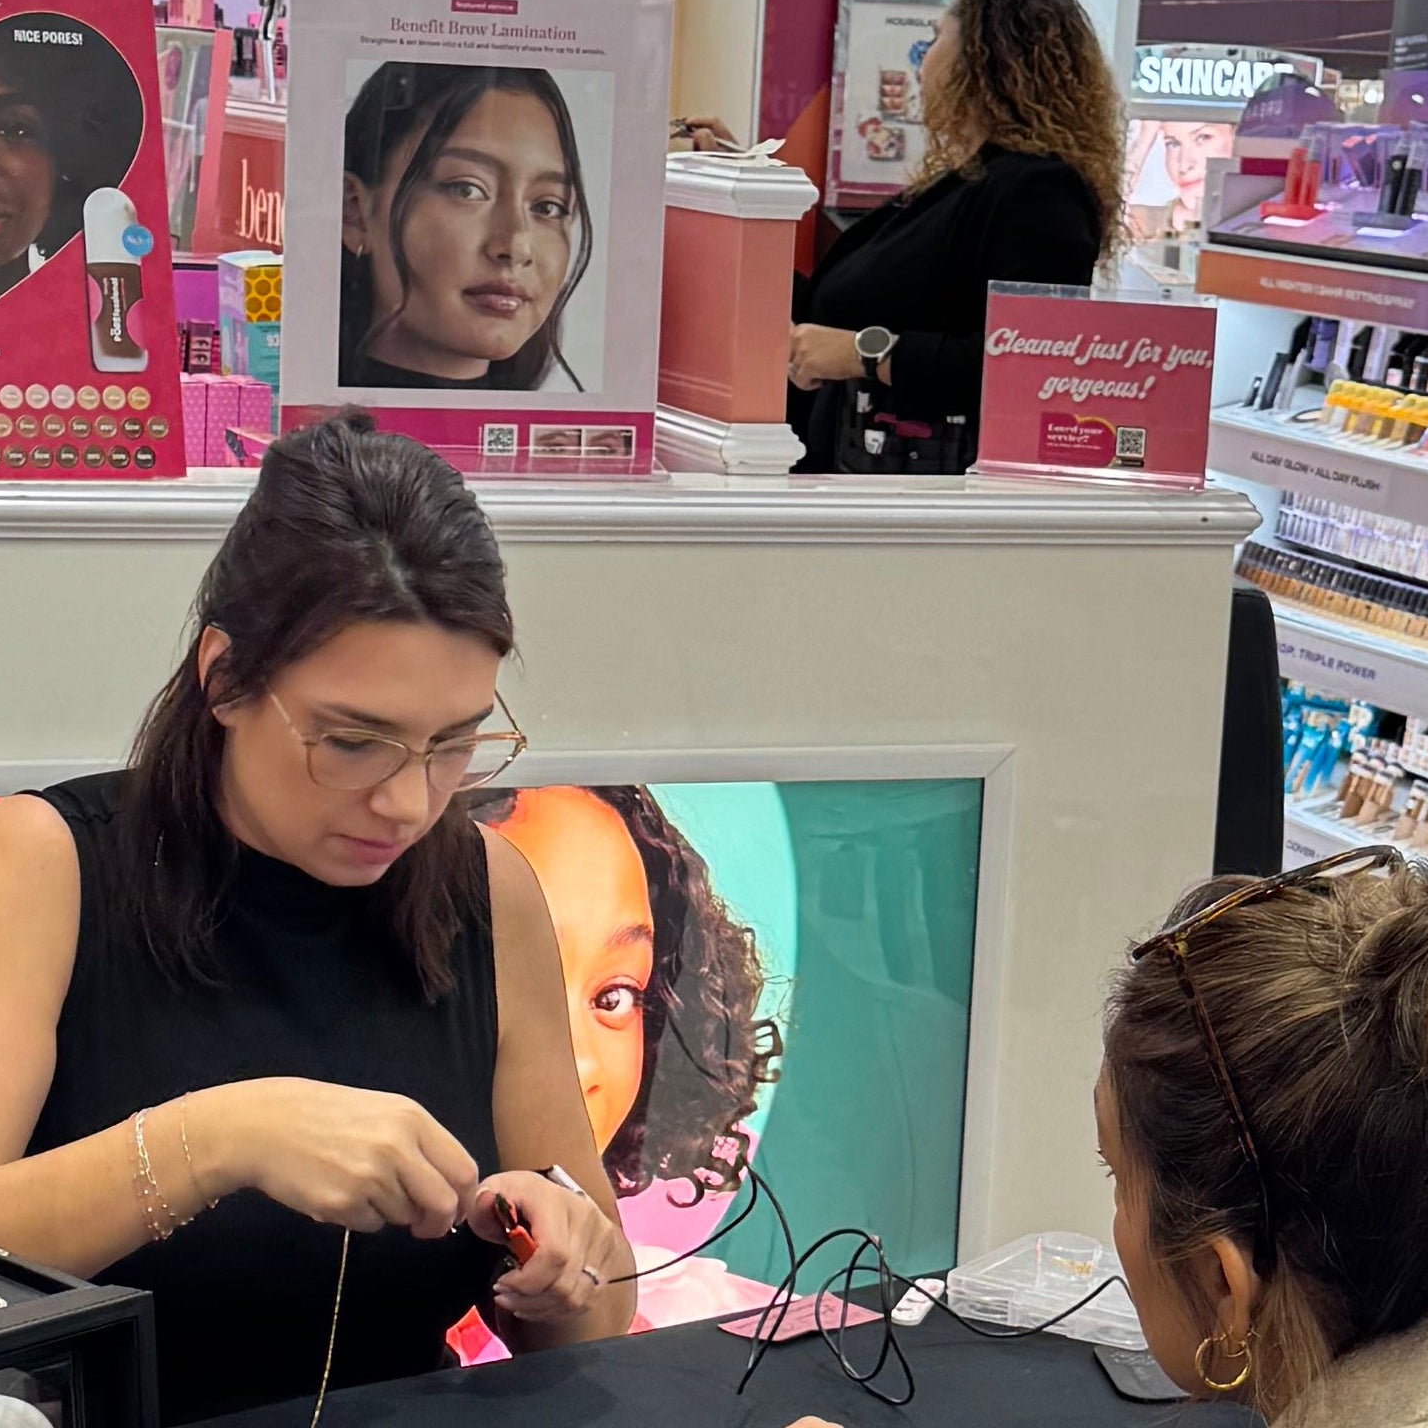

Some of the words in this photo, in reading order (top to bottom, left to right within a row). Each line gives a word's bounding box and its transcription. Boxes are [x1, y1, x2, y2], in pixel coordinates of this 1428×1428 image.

[14, 29, 41, 43] NICE
[43, 31, 83, 45] PORES!
[390, 17, 444, 33] Benefit
[448, 20, 488, 36] Brow
[492, 23, 577, 41] Lamination
[1139, 56, 1294, 99] SKINCAR
[239, 159, 284, 246] ben
[986, 328, 1083, 356] Cleaned
[1074, 335, 1128, 365] just
[1124, 338, 1162, 368] for
[1162, 344, 1214, 371] you,
[1038, 375, 1156, 402] gorgeous!
[1299, 648, 1335, 671] TRIPLE
[1337, 658, 1376, 681] POWER
